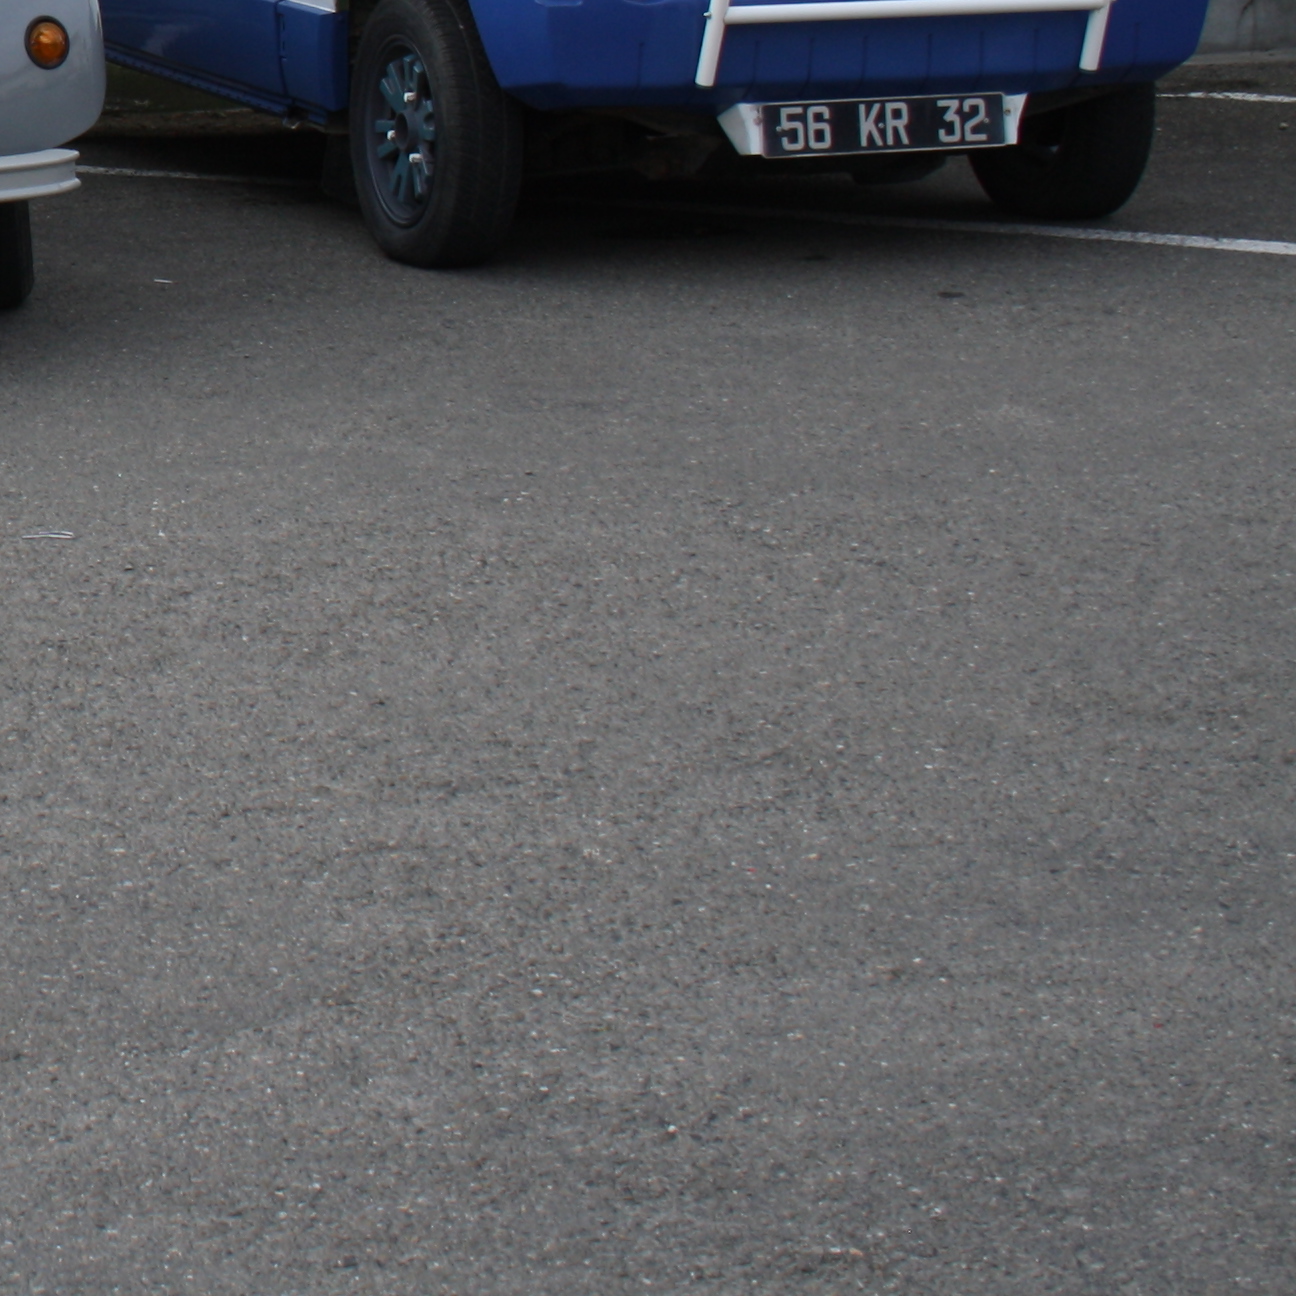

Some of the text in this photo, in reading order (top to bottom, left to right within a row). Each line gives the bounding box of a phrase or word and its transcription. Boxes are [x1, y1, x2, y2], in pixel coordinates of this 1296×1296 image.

[779, 98, 988, 151] 56 KR 32
